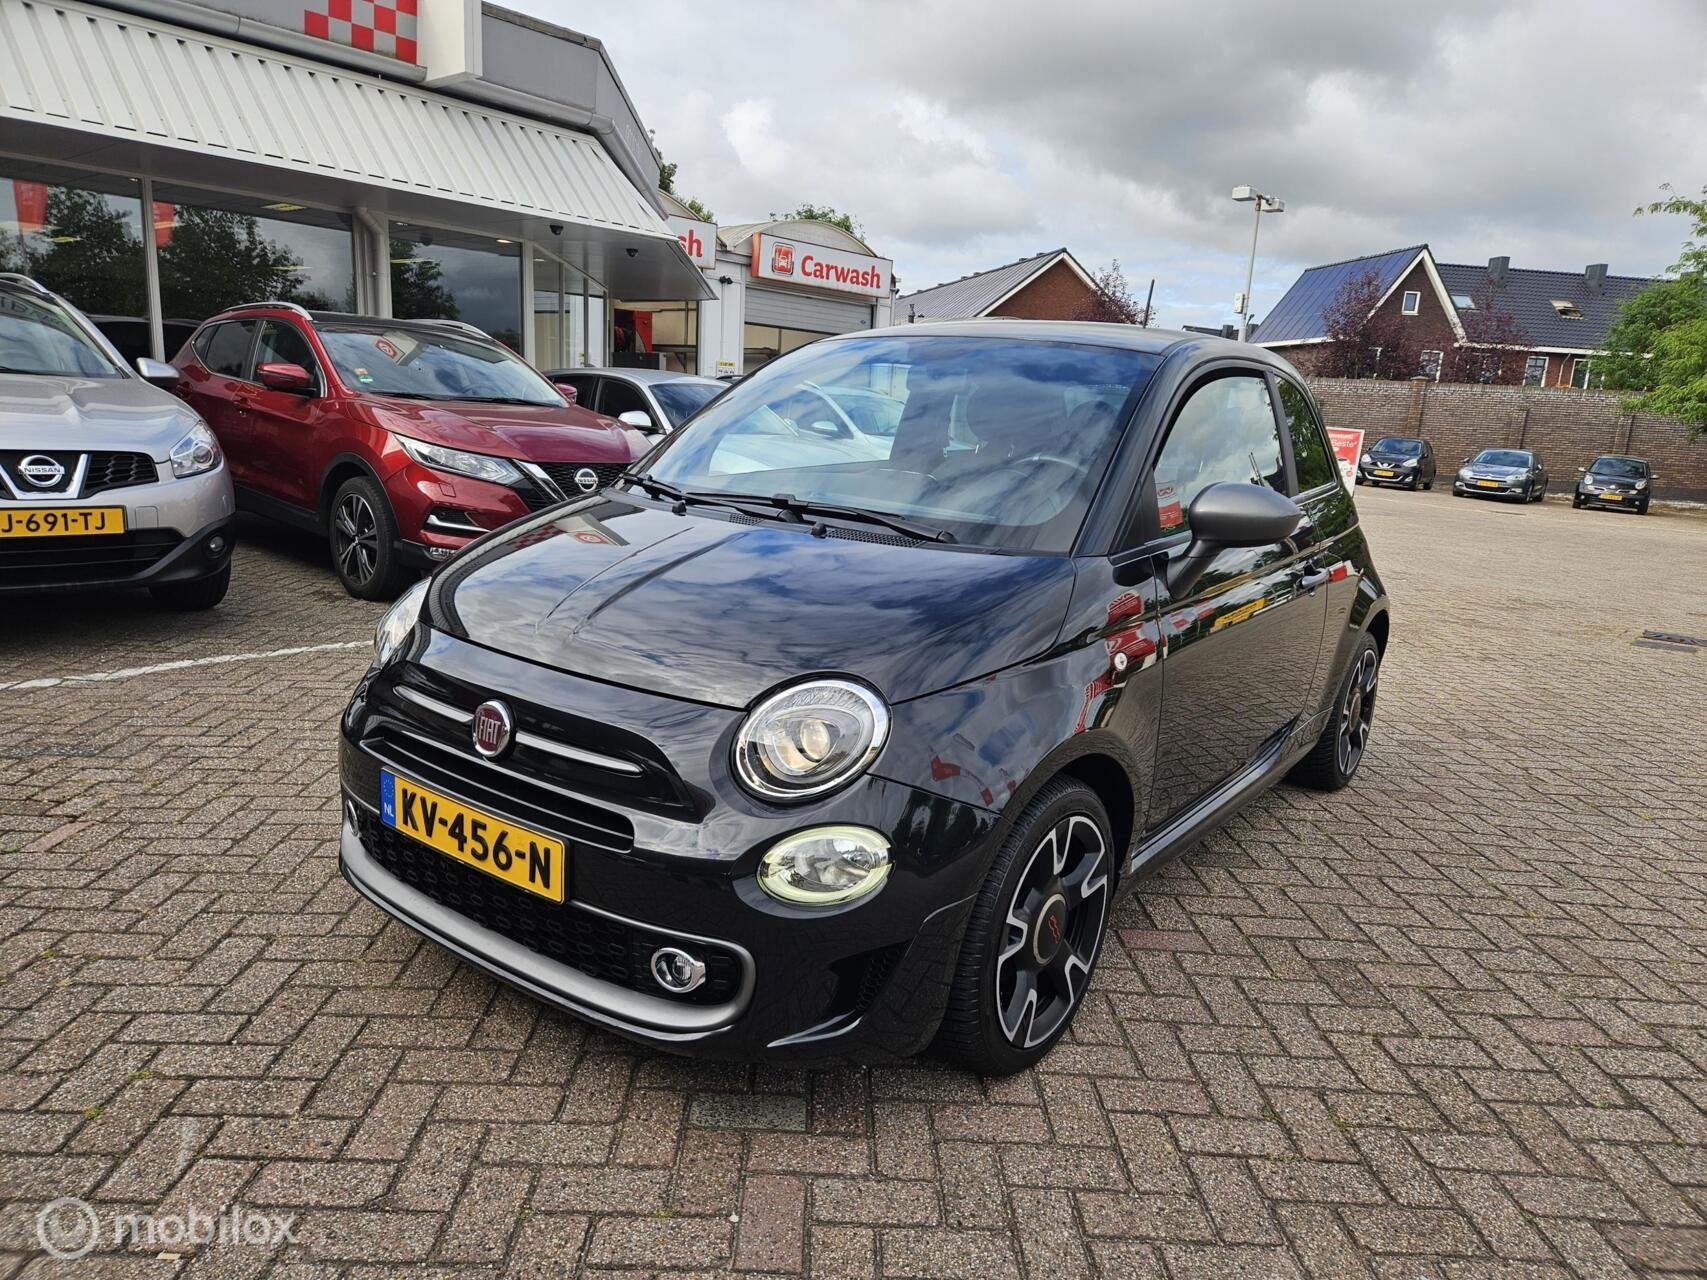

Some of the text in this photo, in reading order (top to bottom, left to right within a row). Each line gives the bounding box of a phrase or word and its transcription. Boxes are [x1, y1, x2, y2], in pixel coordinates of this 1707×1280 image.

[801, 255, 881, 289] Carwash
[1, 511, 106, 533] J-691-TJ
[478, 715, 502, 745] FIAT
[384, 802, 395, 818] NL
[401, 787, 551, 890] KV-456-N
